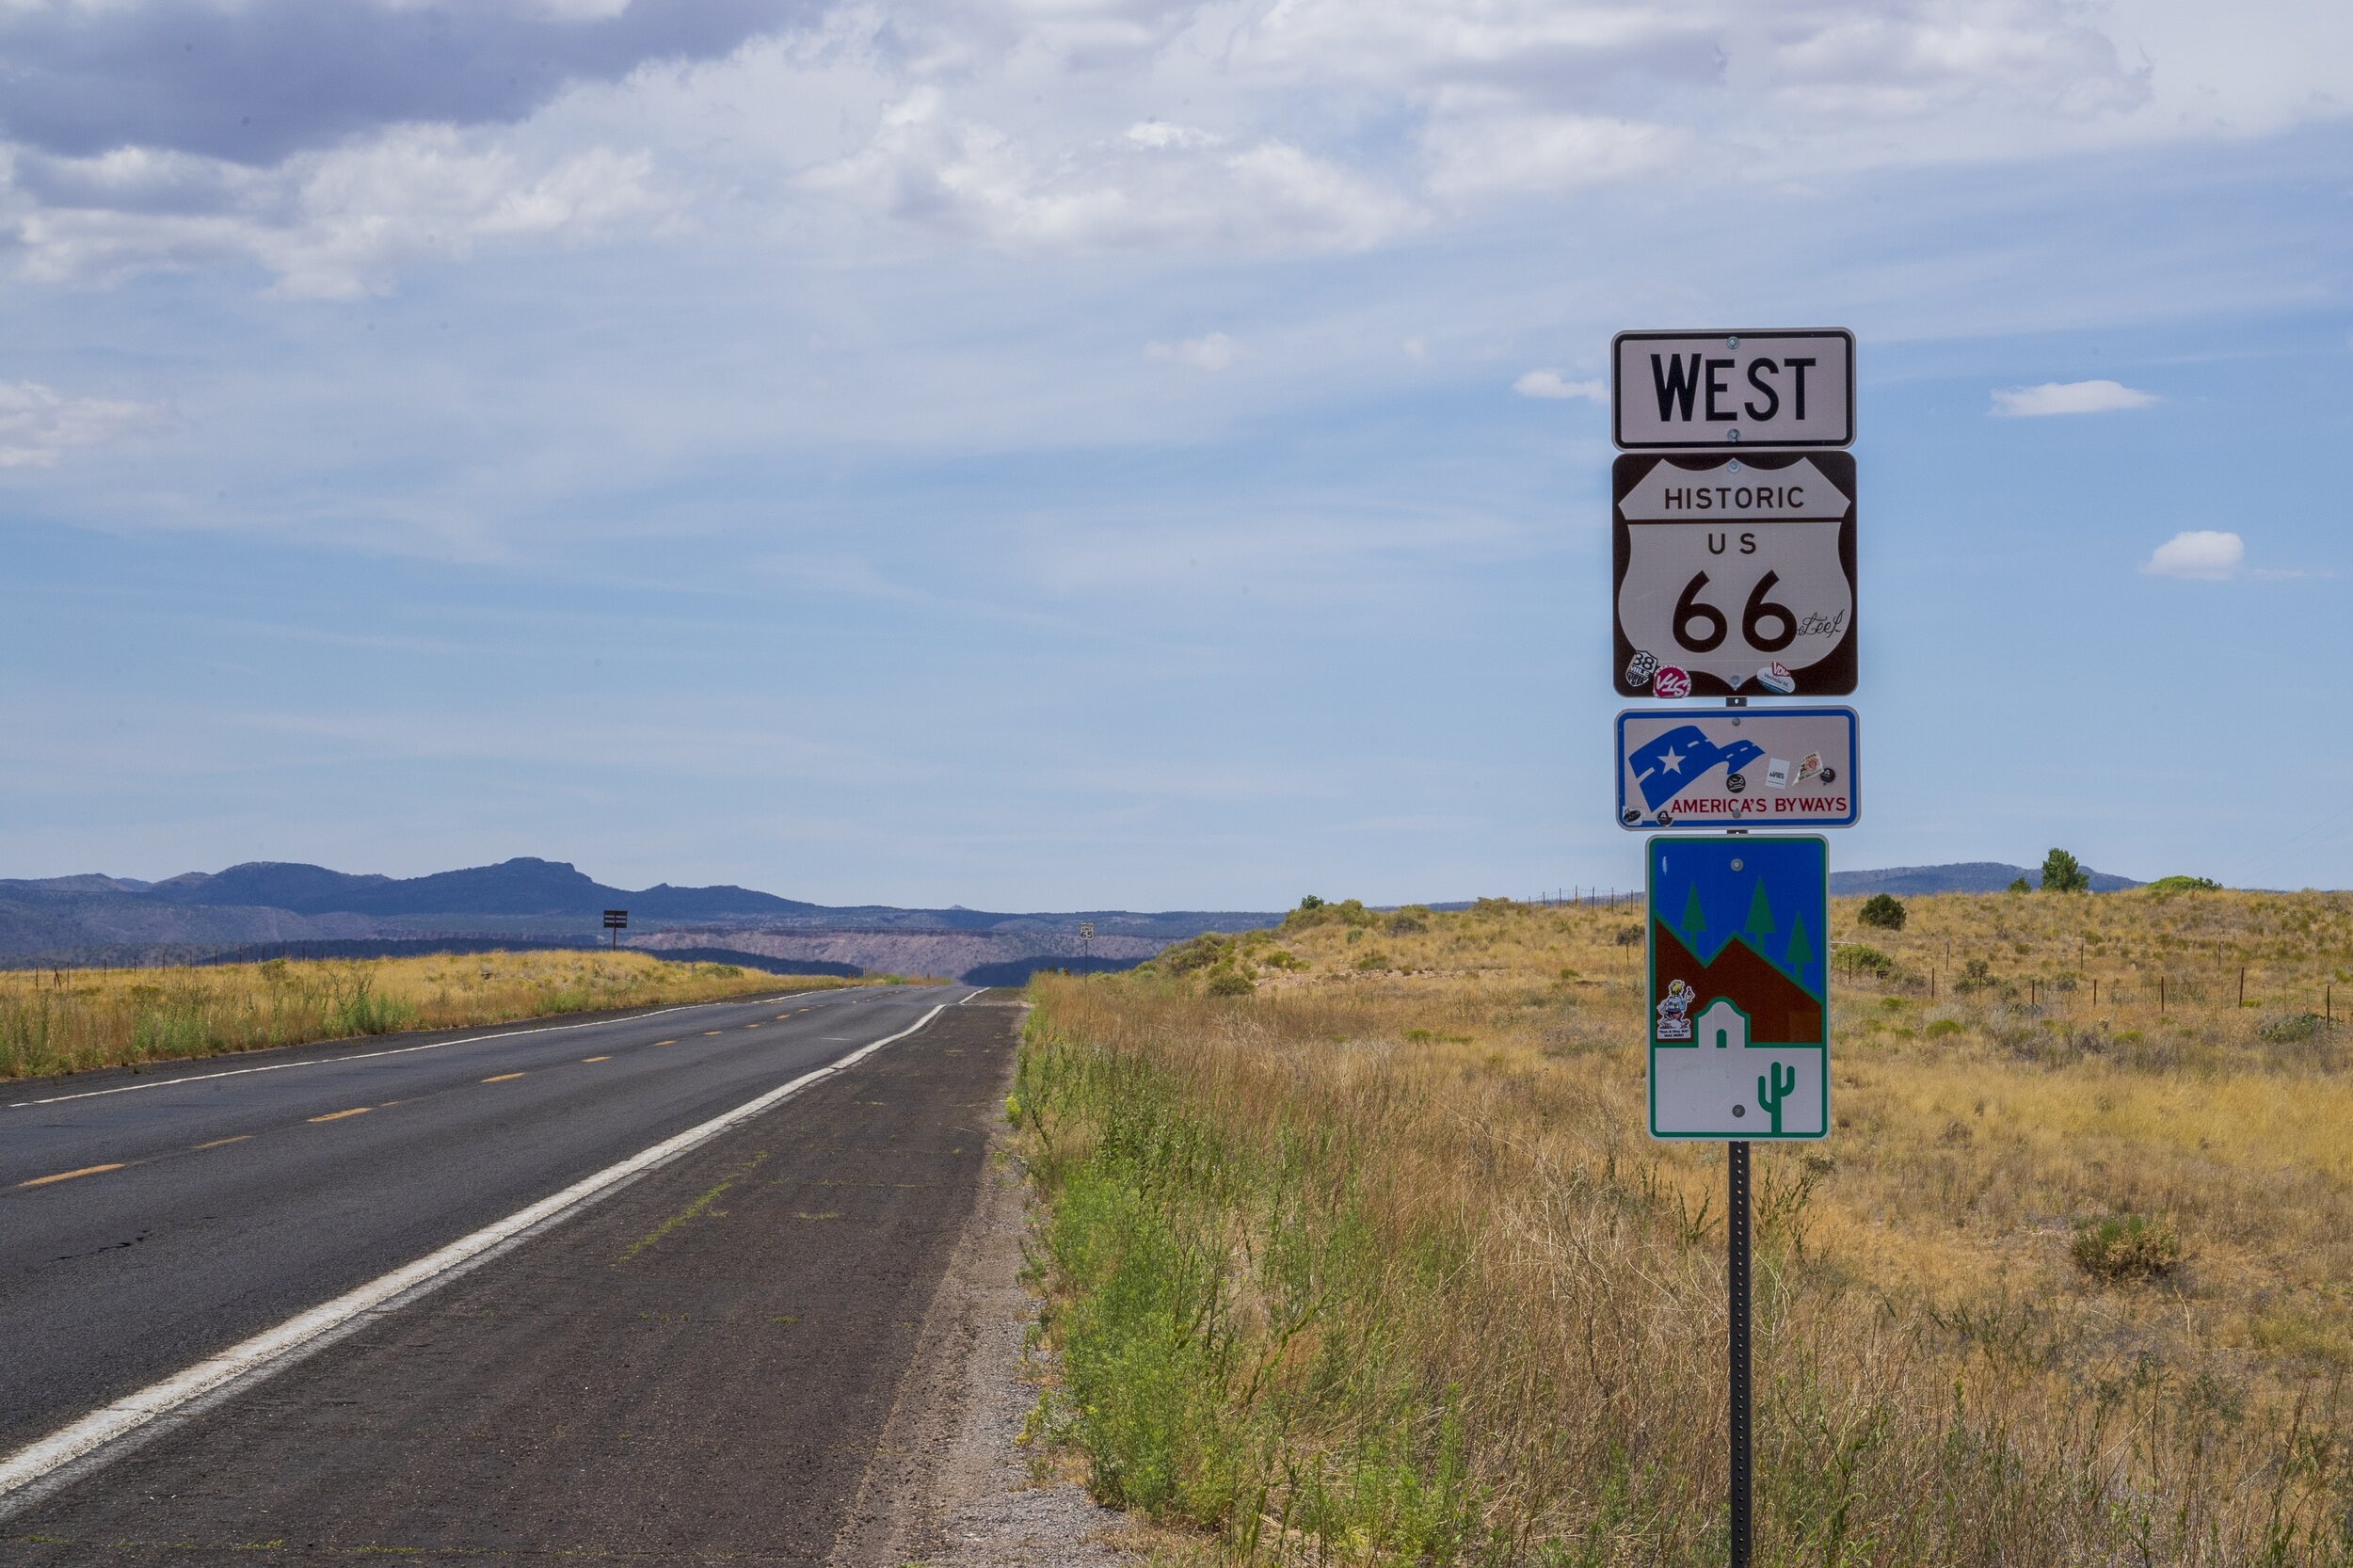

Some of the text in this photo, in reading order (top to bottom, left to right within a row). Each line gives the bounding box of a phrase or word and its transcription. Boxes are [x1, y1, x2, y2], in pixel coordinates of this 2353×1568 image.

[1650, 353, 1817, 422] WEST
[1664, 487, 1804, 509] HISTORIC
[1673, 569, 1797, 653] 66
[1633, 653, 1655, 671] 38
[1671, 797, 1847, 813] AMERICA'S BYWAYS
